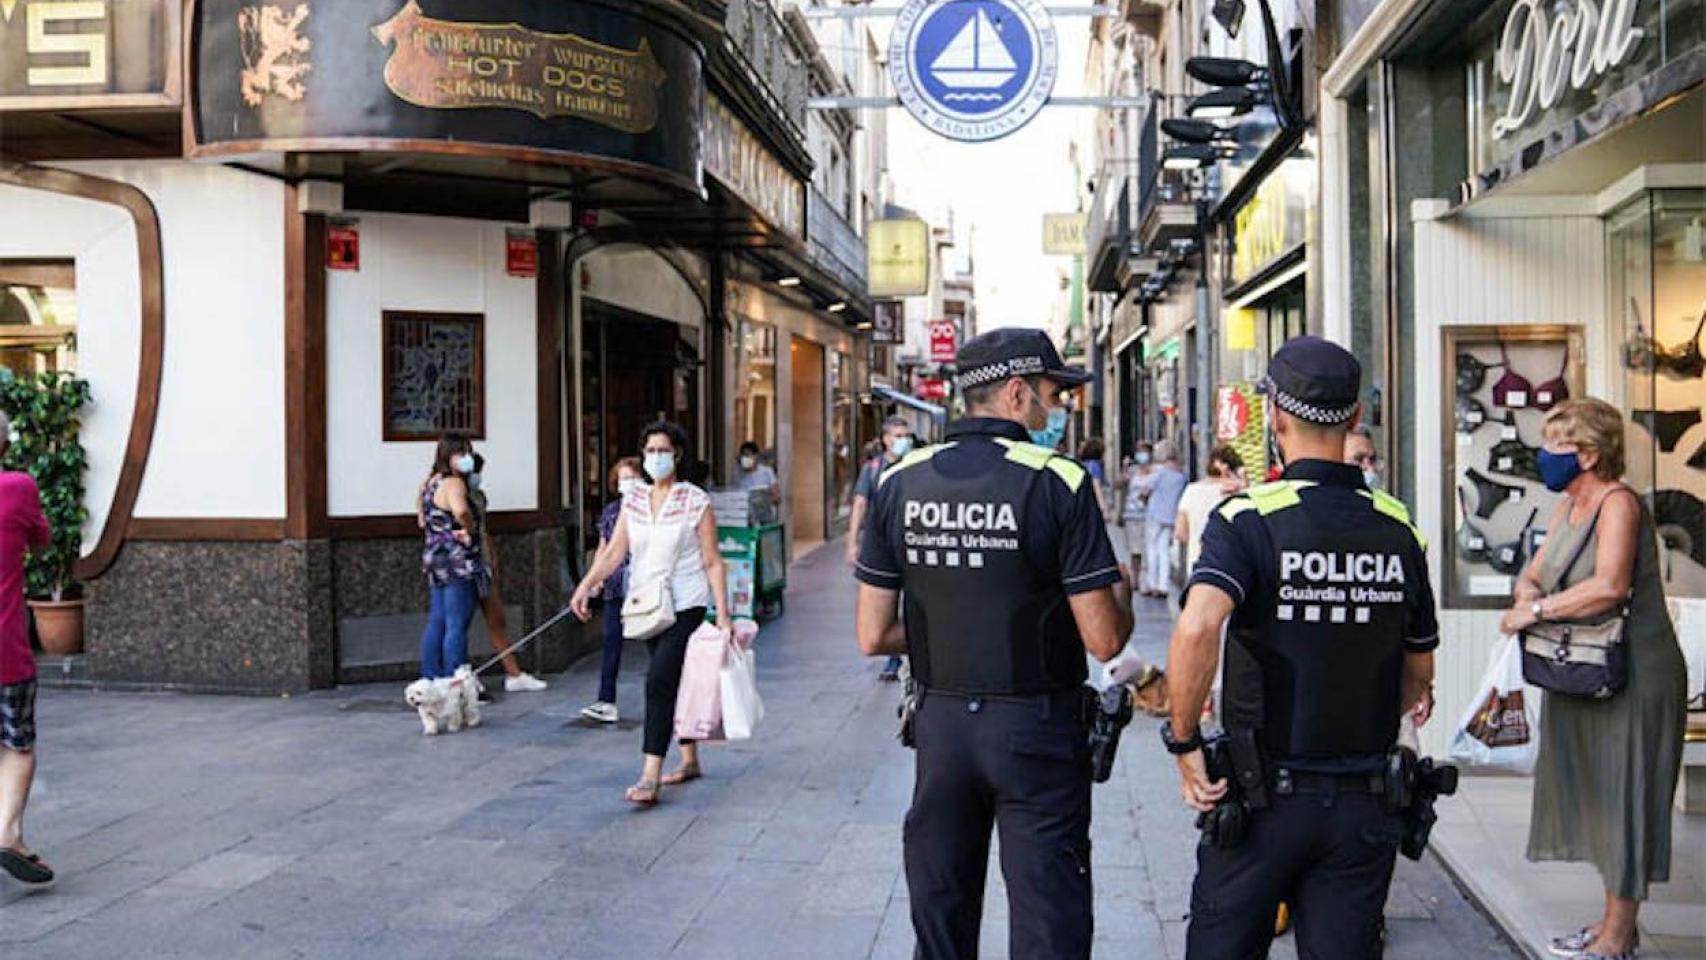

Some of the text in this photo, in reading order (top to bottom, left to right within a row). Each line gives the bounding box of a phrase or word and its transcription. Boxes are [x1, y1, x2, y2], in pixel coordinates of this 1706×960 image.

[449, 56, 627, 98] HOT DOGS
[932, 114, 1018, 137] BADALONA
[1009, 356, 1042, 370] POLICIA
[904, 500, 1019, 531] POLICIA
[960, 533, 1019, 550] Urbana
[1281, 551, 1405, 584] POLICIA
[1350, 586, 1404, 603] Urbana
